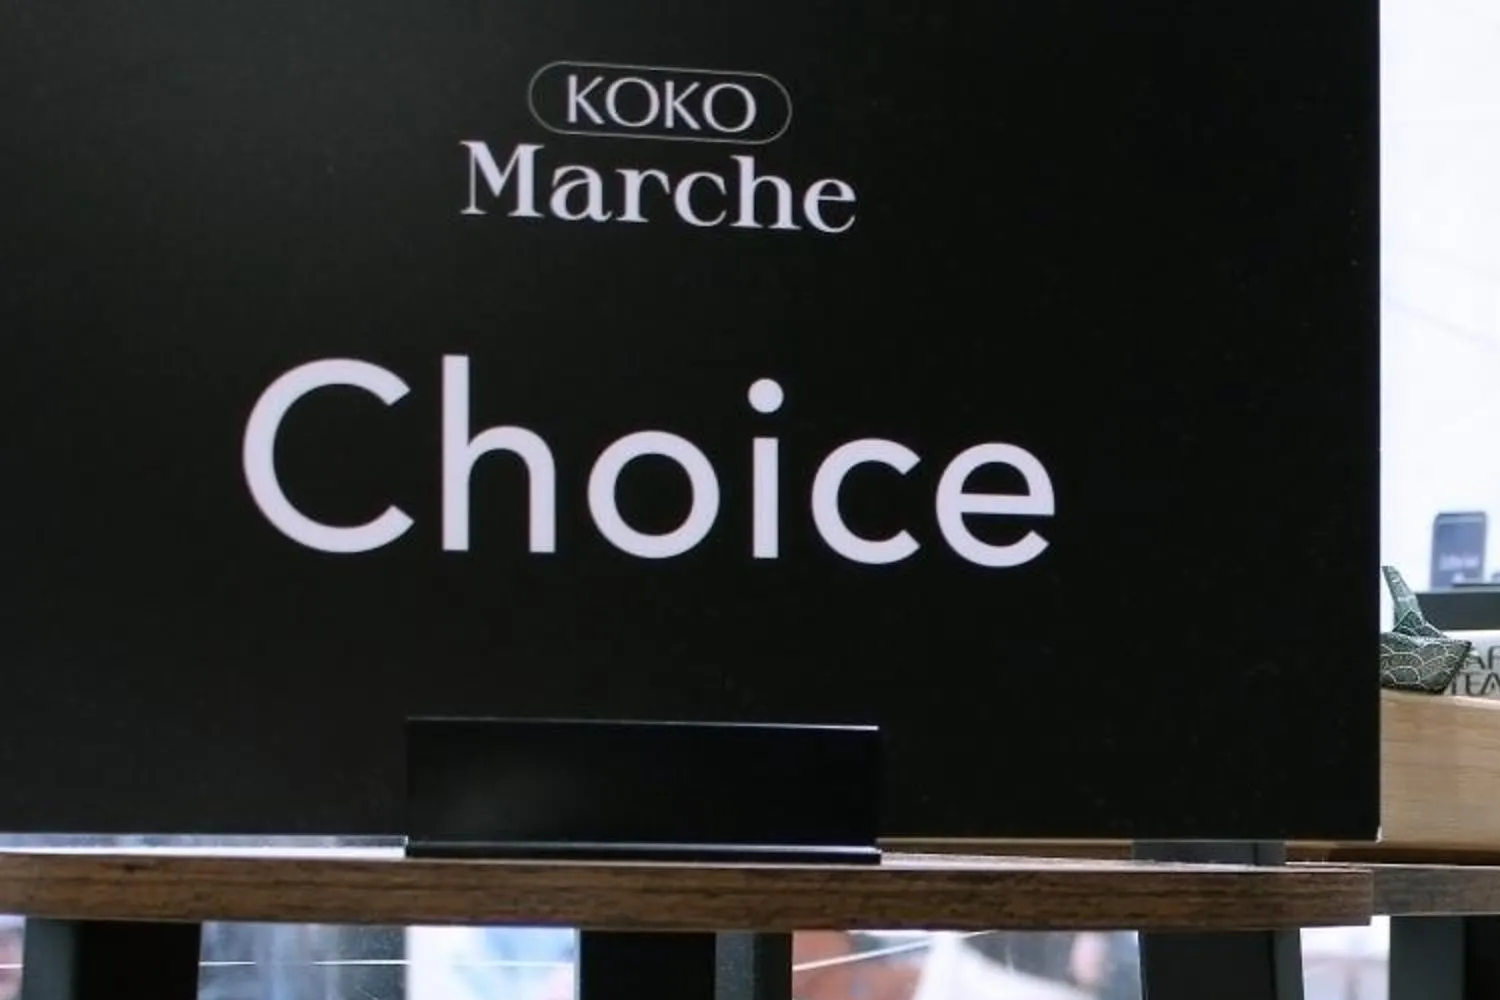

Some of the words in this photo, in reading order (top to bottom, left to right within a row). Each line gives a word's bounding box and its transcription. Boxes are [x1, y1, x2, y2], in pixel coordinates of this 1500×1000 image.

[566, 74, 757, 134] KOKO
[460, 140, 858, 233] Marche
[242, 354, 1056, 567] Choice
